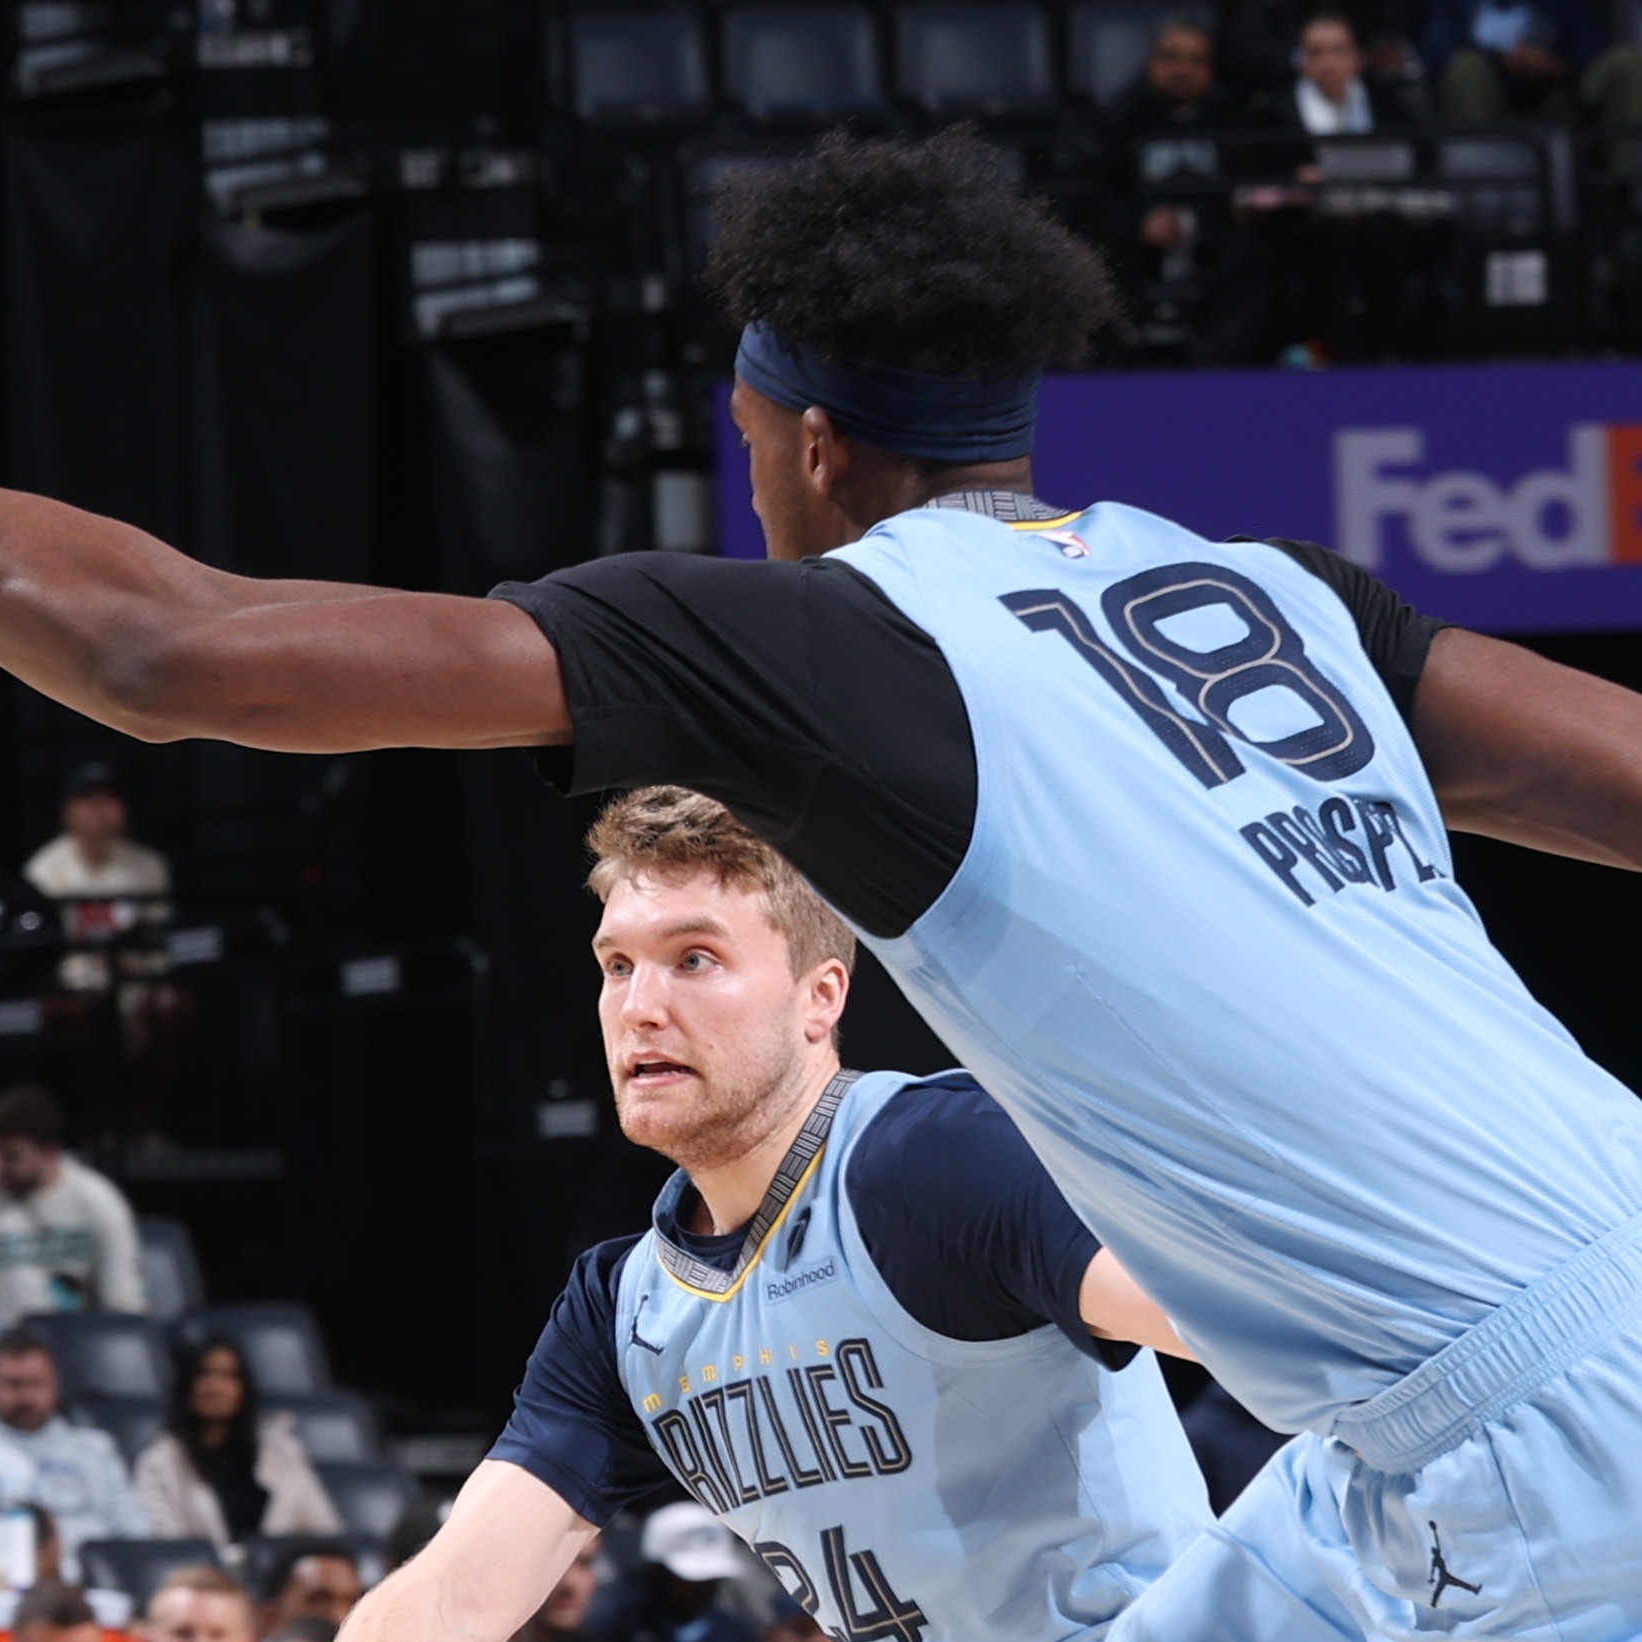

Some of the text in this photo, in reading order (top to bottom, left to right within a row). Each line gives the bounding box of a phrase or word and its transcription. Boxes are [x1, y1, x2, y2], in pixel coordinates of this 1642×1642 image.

[996, 561, 1376, 791] 18
[767, 1259, 836, 1301] Robinhood
[651, 1337, 913, 1516] RIZZLIES
